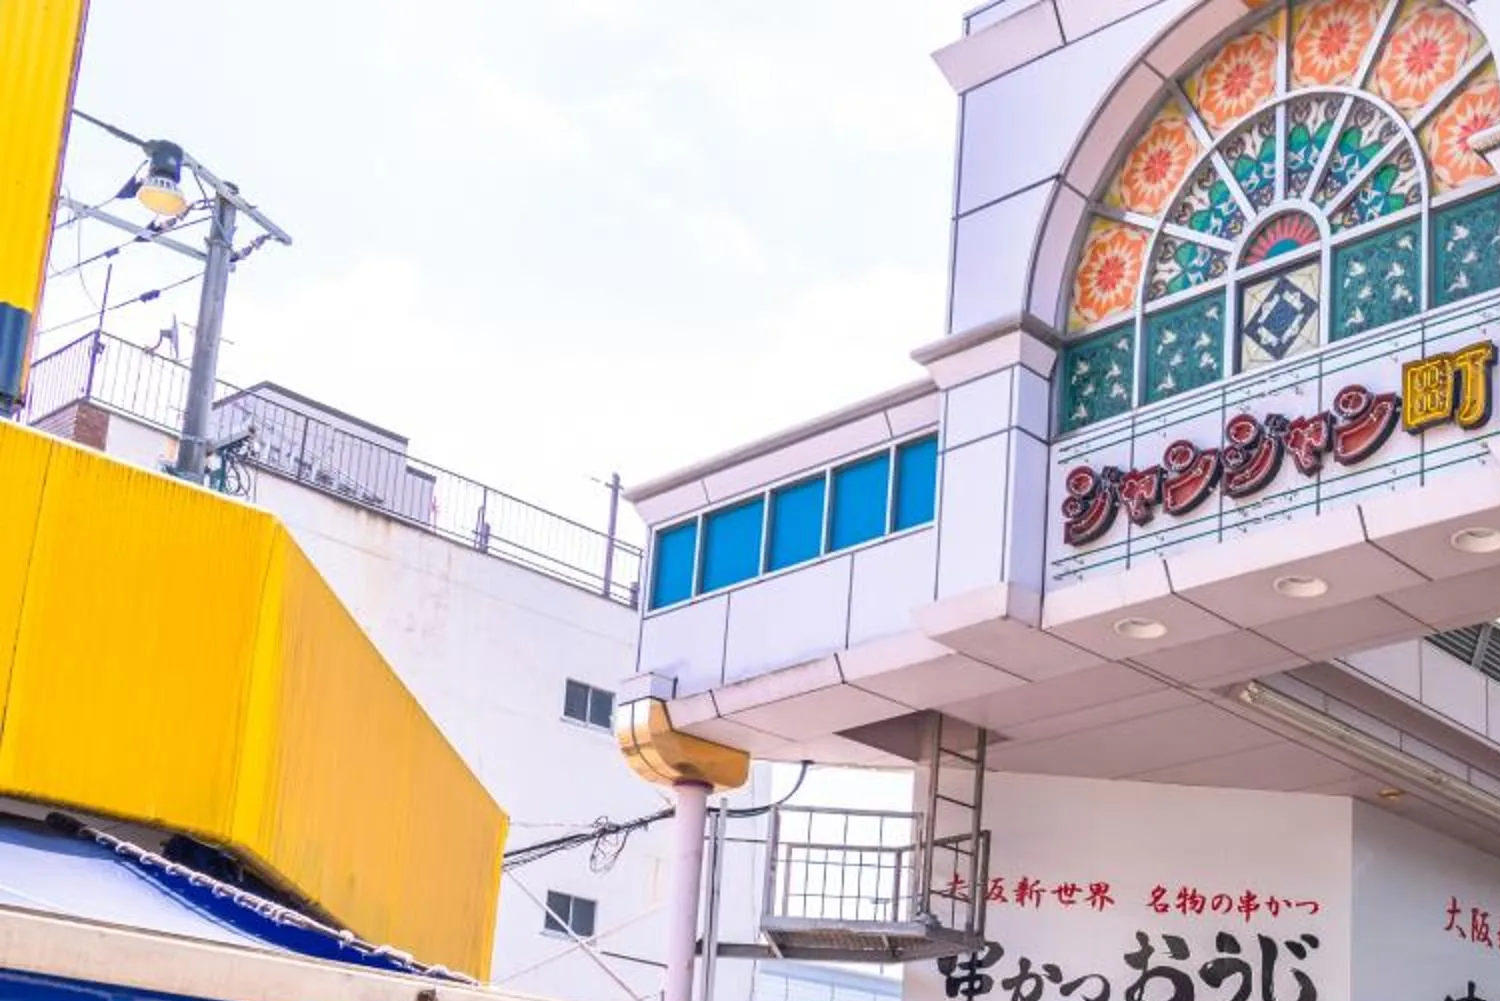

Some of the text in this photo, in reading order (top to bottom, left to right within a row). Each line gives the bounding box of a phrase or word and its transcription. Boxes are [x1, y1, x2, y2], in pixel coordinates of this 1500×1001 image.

[1145, 882, 1321, 923] 名物の串かつ
